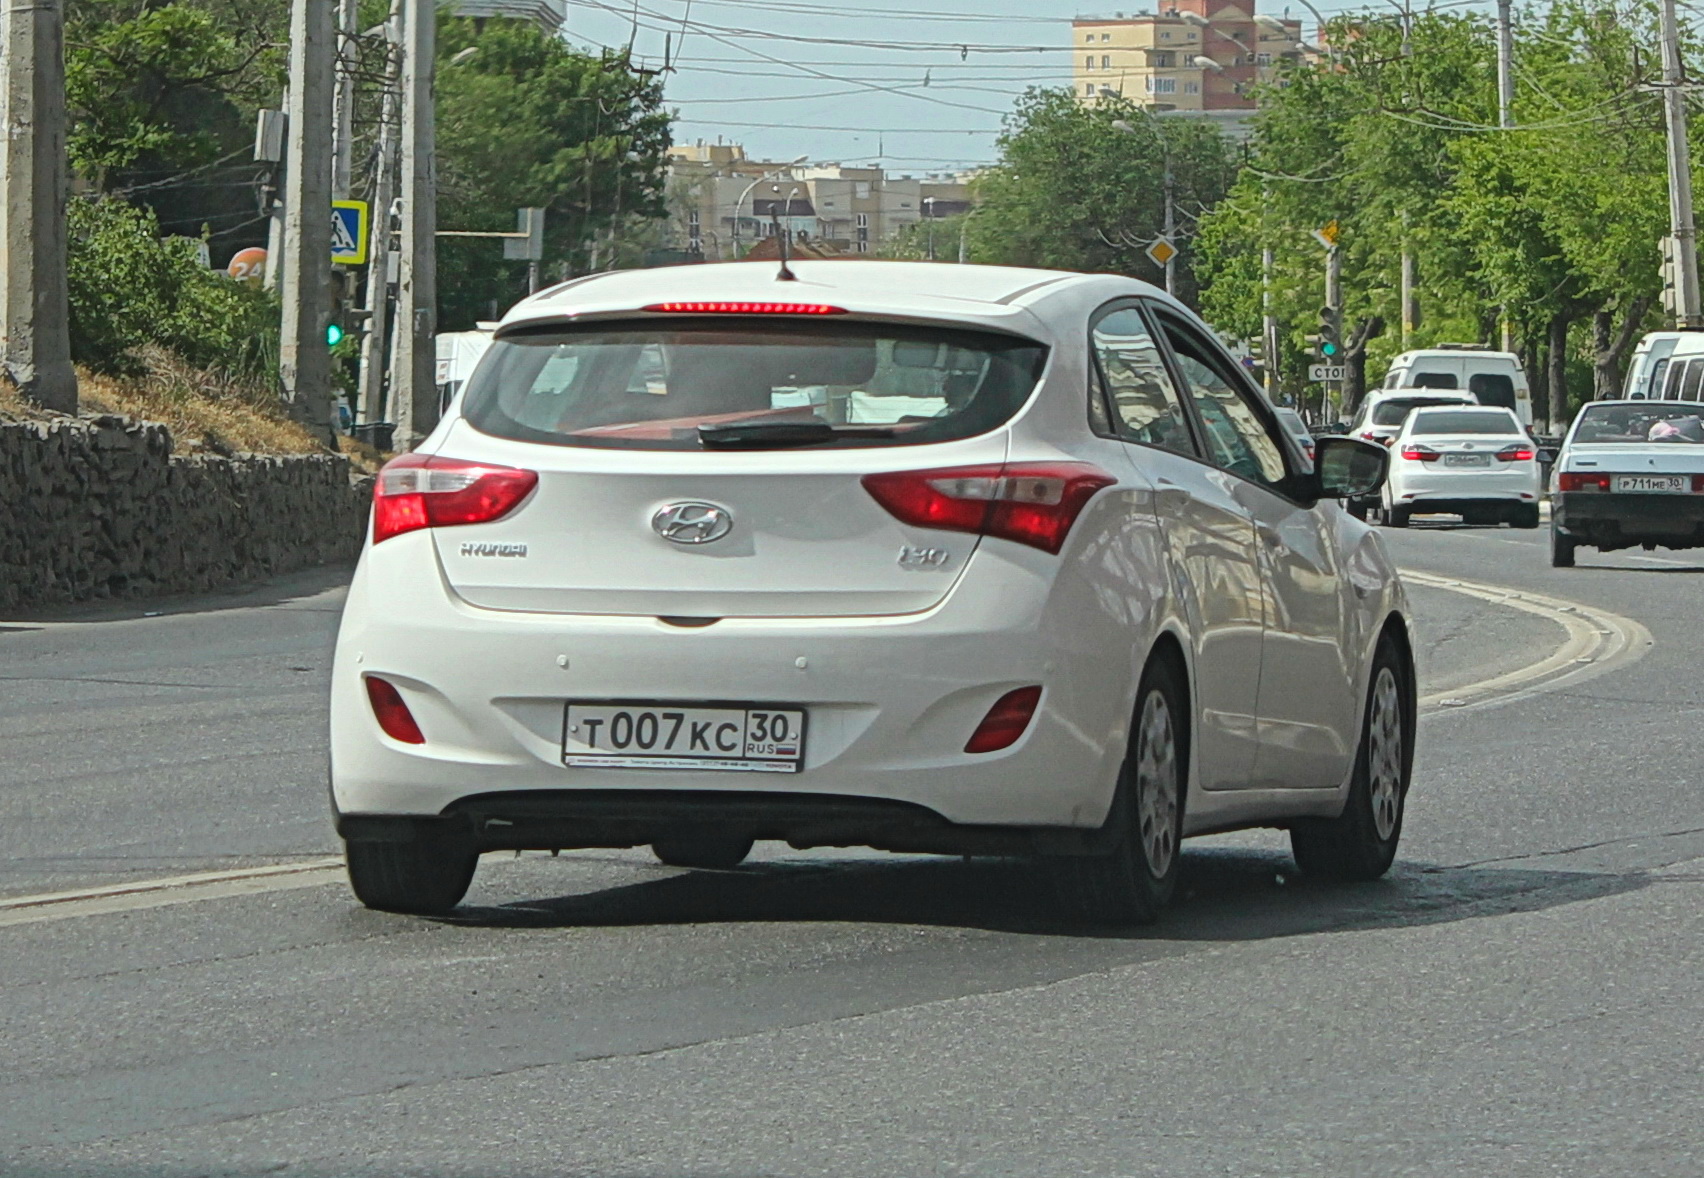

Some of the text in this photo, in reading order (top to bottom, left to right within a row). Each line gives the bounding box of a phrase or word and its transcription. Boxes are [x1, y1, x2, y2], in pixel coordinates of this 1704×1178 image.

[461, 542, 527, 557] HYUNDAI
[750, 713, 789, 742] 30
[747, 743, 774, 754] RUS
